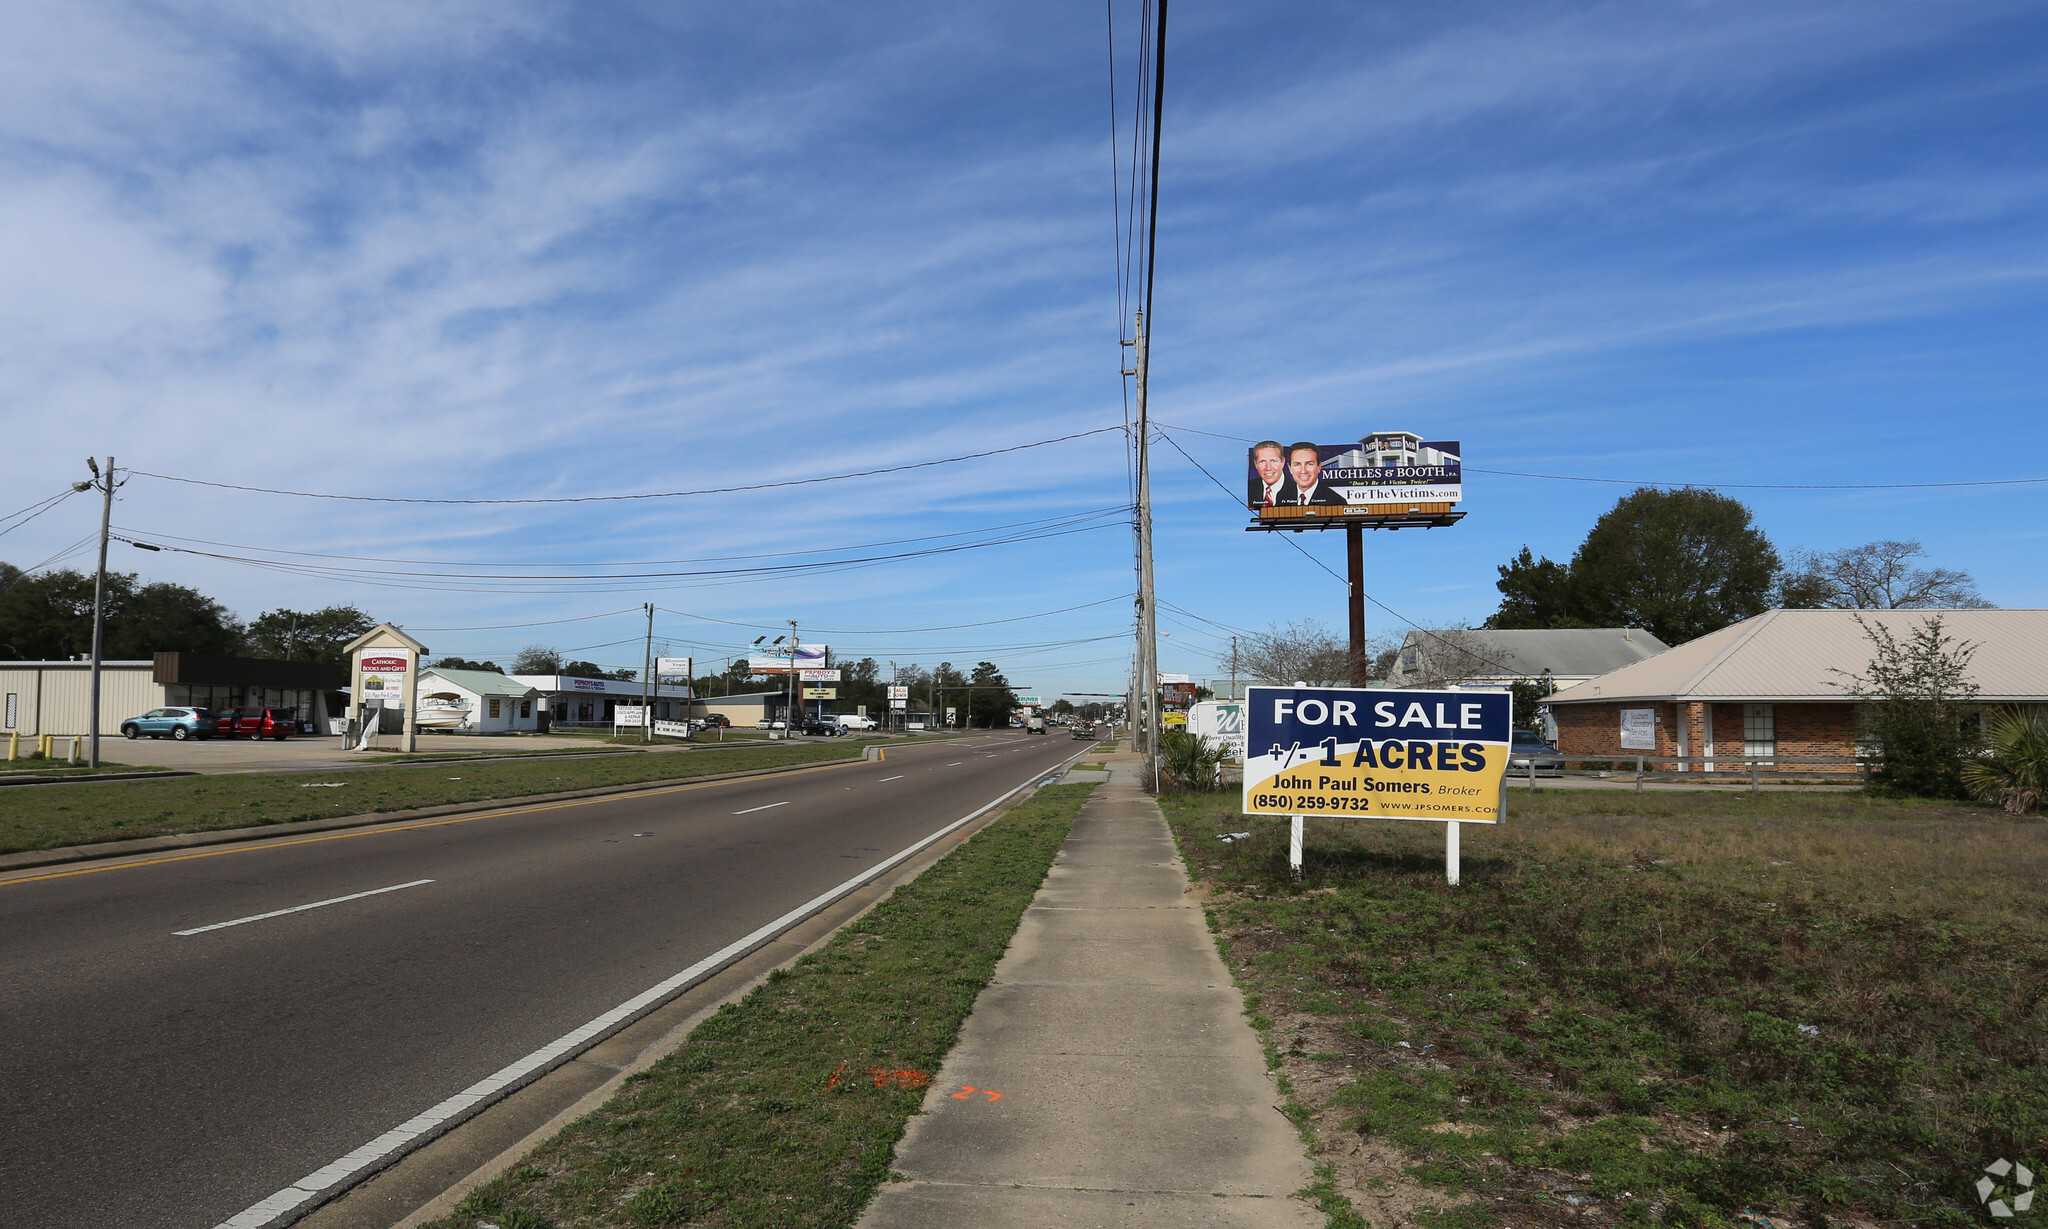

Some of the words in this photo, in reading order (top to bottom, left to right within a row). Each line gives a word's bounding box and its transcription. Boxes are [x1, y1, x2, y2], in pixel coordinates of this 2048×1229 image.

[1322, 468, 1382, 480] MICHLES
[1384, 469, 1394, 478] &
[1346, 487, 1459, 500] ForTheVictims.com
[1275, 699, 1358, 726] FOR
[1374, 701, 1482, 729] SALE
[1269, 742, 1307, 769] +/-
[1320, 736, 1341, 767] 1
[1353, 739, 1486, 772] ACRES
[1273, 774, 1312, 789] John
[1319, 775, 1357, 791] Paul
[1363, 777, 1433, 795] Somers,
[1438, 785, 1482, 796] Broker
[1253, 794, 1293, 810] (850)
[1296, 796, 1369, 811] 259-9732
